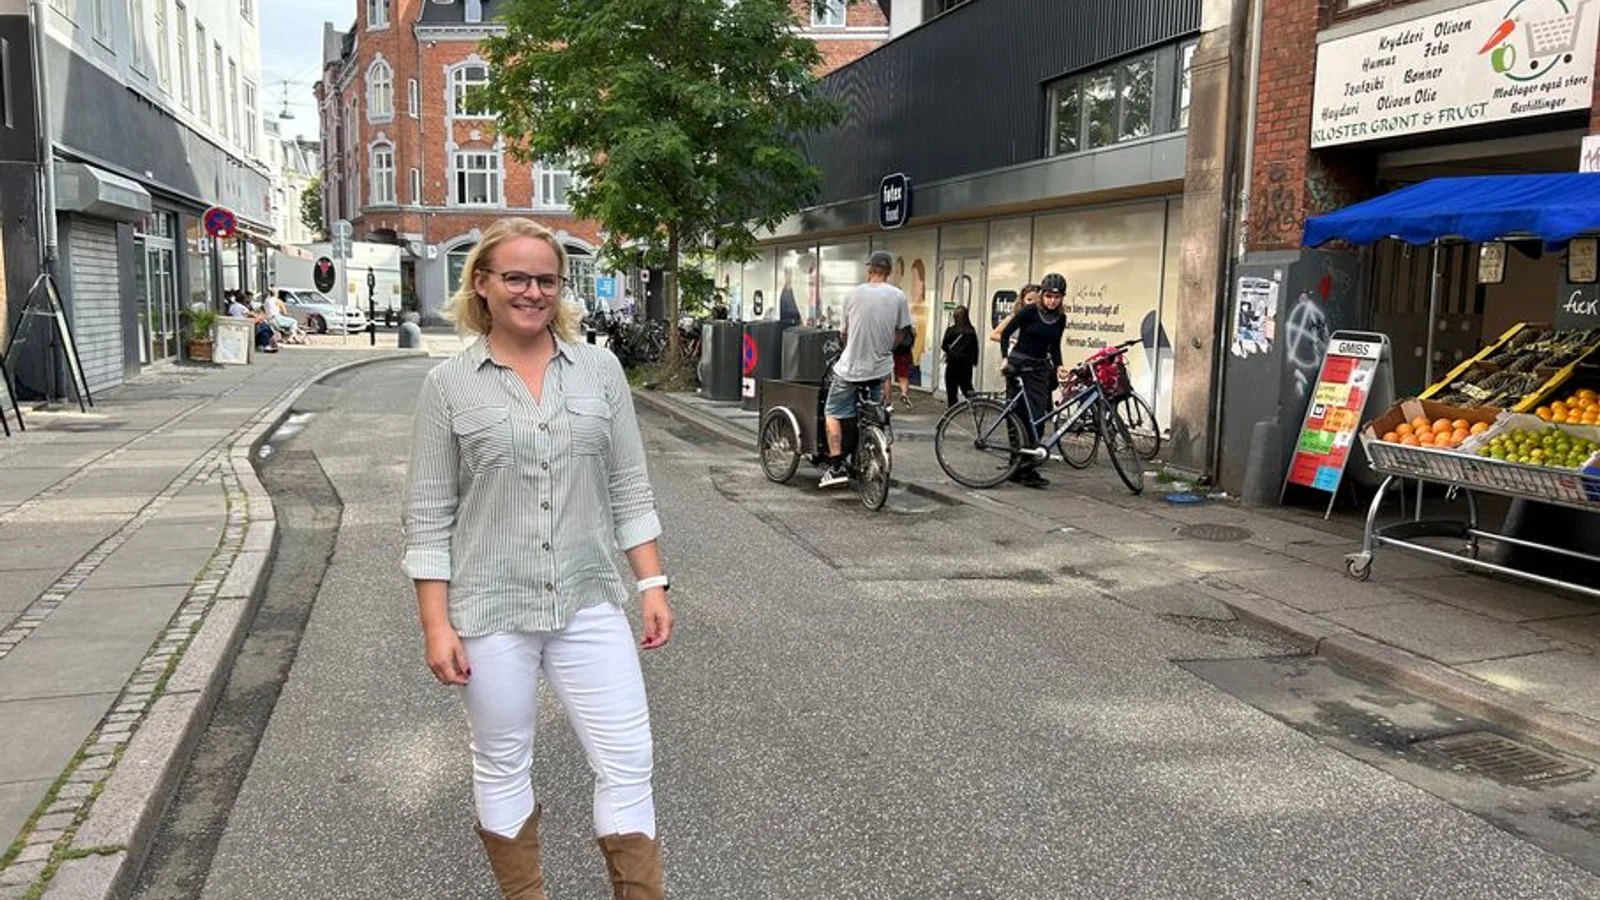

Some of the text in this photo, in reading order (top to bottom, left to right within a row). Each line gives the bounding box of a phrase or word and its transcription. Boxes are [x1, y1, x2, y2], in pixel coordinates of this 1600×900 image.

[1379, 20, 1472, 51] Krydderi Oliven
[1362, 41, 1449, 72] Humus Feta
[1565, 75, 1588, 87] store
[1321, 88, 1437, 121] Haydari Oliven Olie
[1313, 102, 1489, 142] KLOSTER GRØNT & FRUGT
